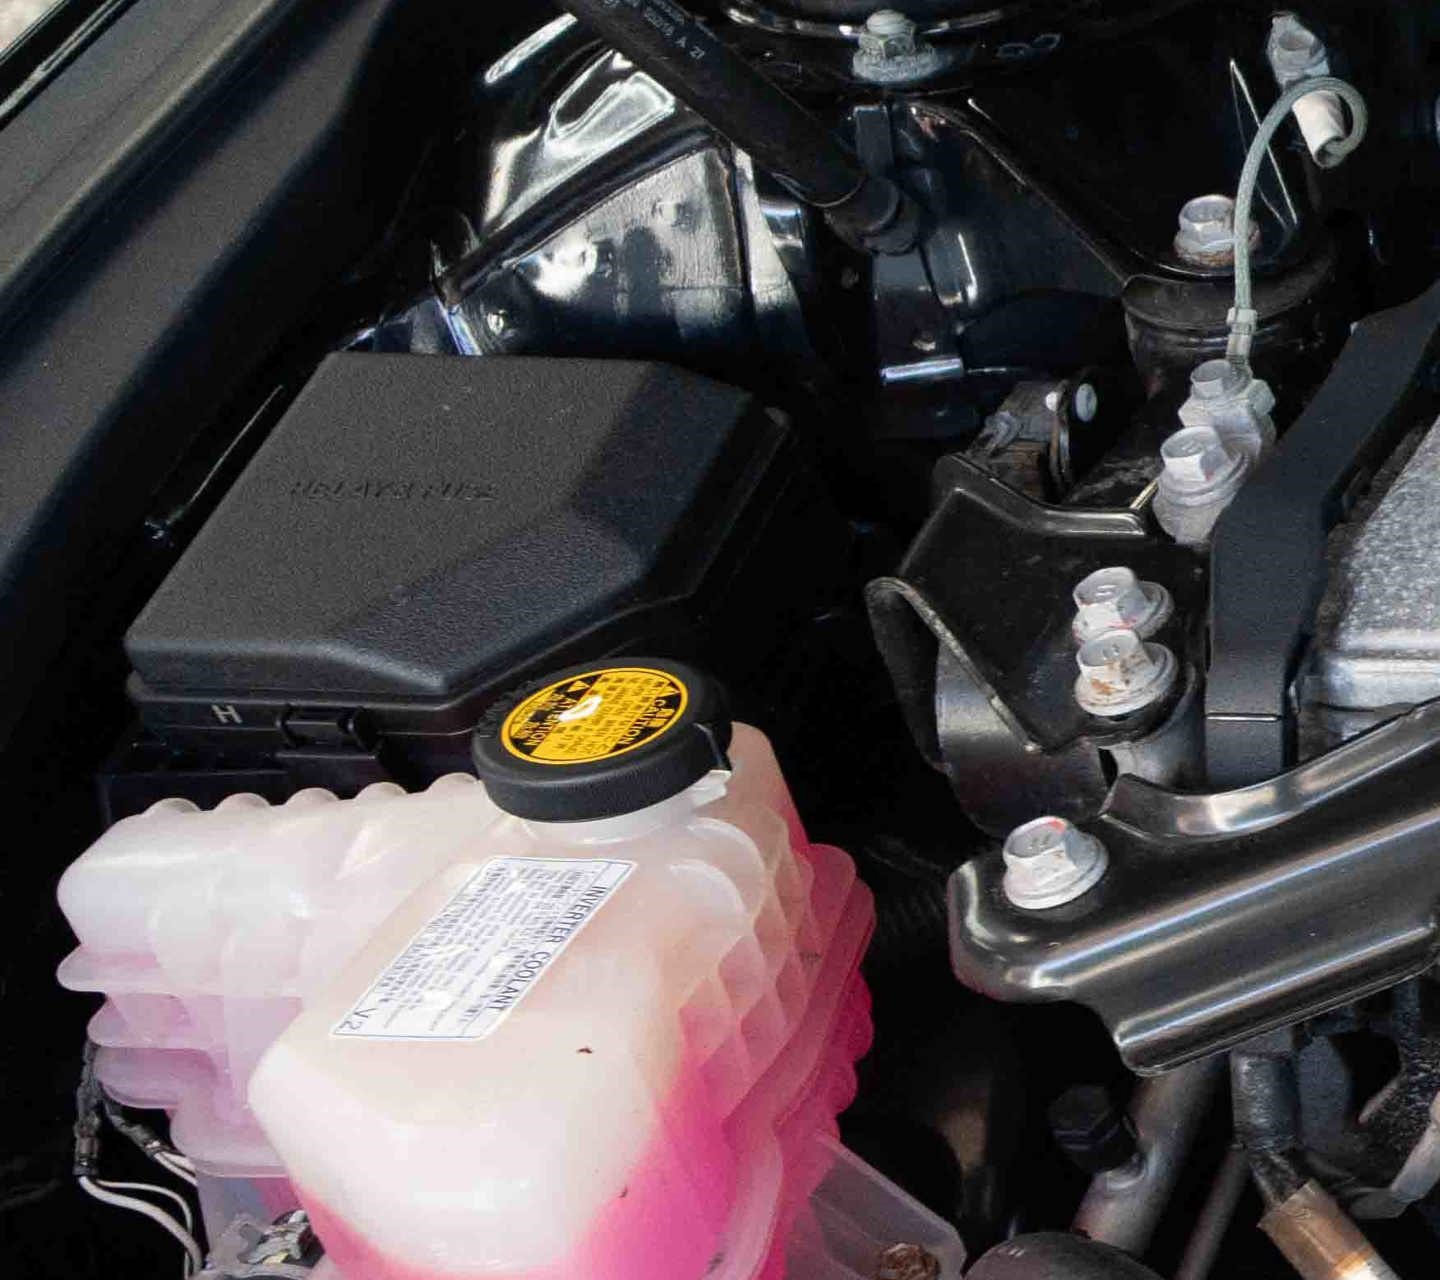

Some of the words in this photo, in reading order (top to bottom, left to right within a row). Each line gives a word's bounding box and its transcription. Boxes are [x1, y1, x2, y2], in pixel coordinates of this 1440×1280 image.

[211, 704, 243, 724] H
[618, 699, 667, 745] CAUTION
[546, 885, 607, 944] INVERTER
[487, 950, 551, 1011] COOLANT
